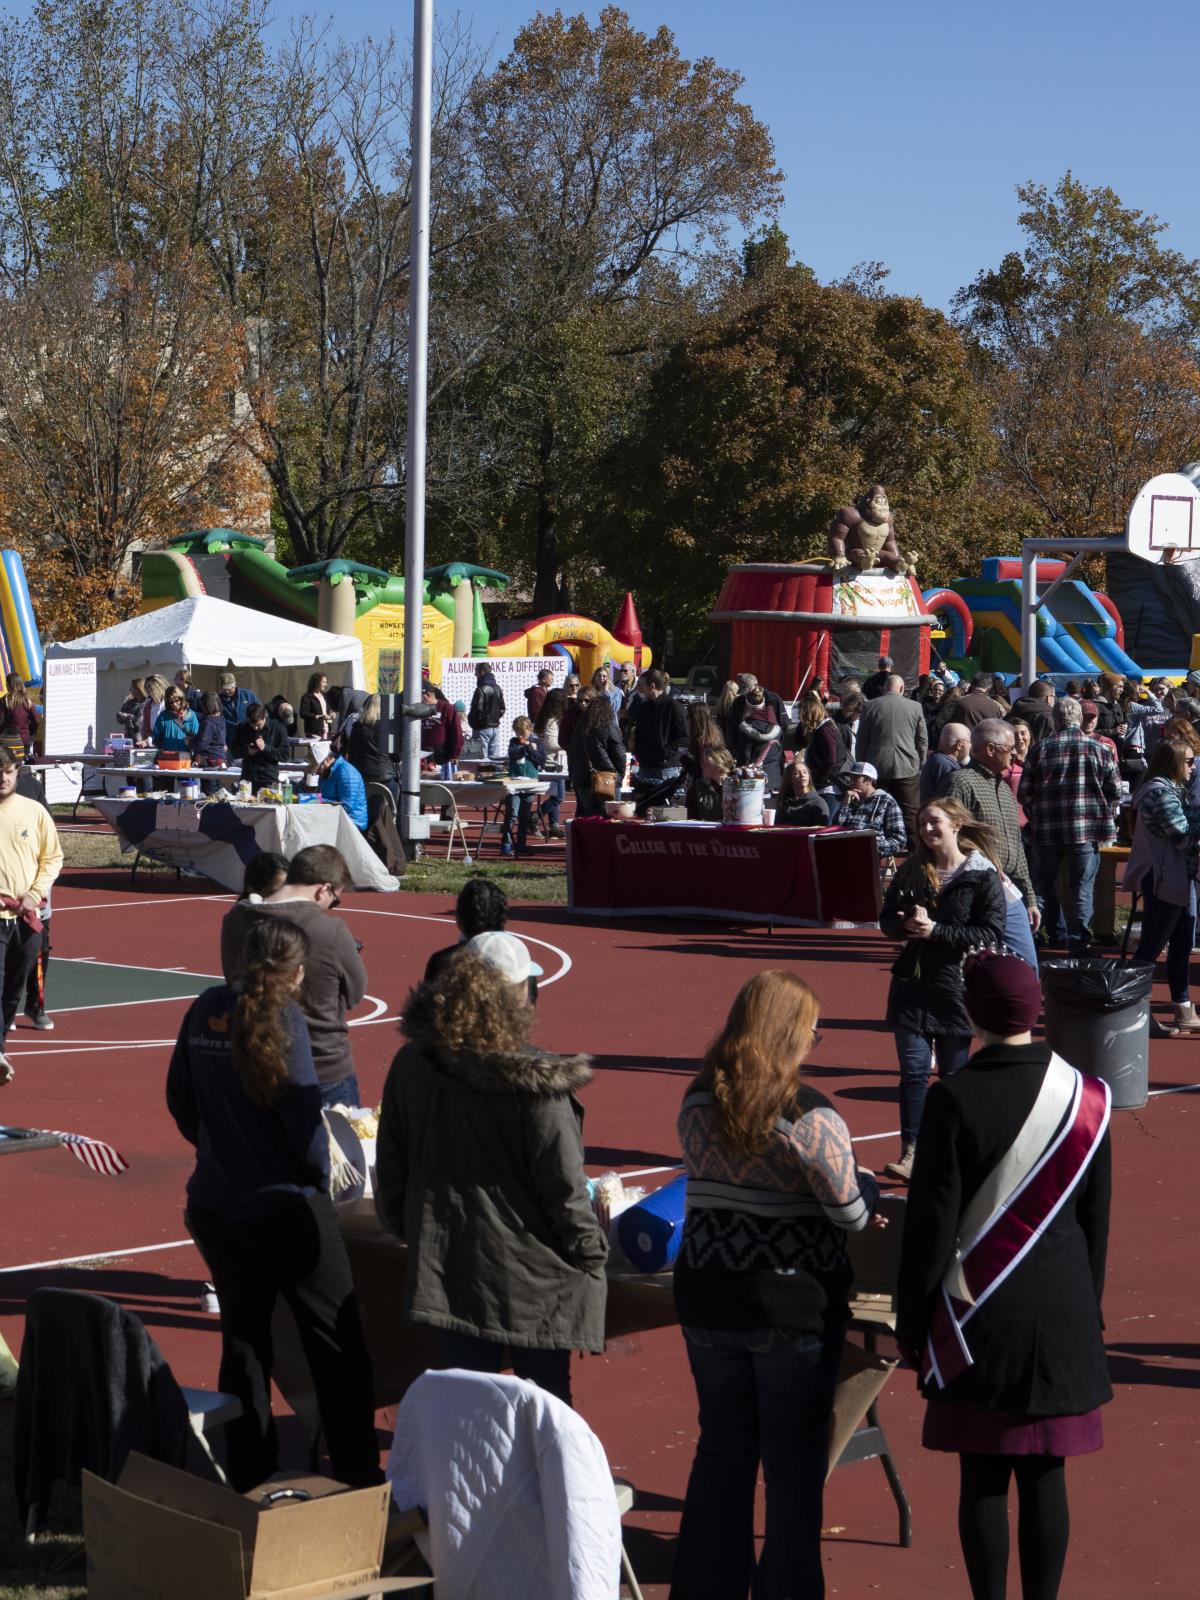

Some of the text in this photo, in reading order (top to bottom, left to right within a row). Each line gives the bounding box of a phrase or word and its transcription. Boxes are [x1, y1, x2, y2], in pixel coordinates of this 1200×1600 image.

[447, 660, 564, 673] ALUMN AKE A DIFFERENCE
